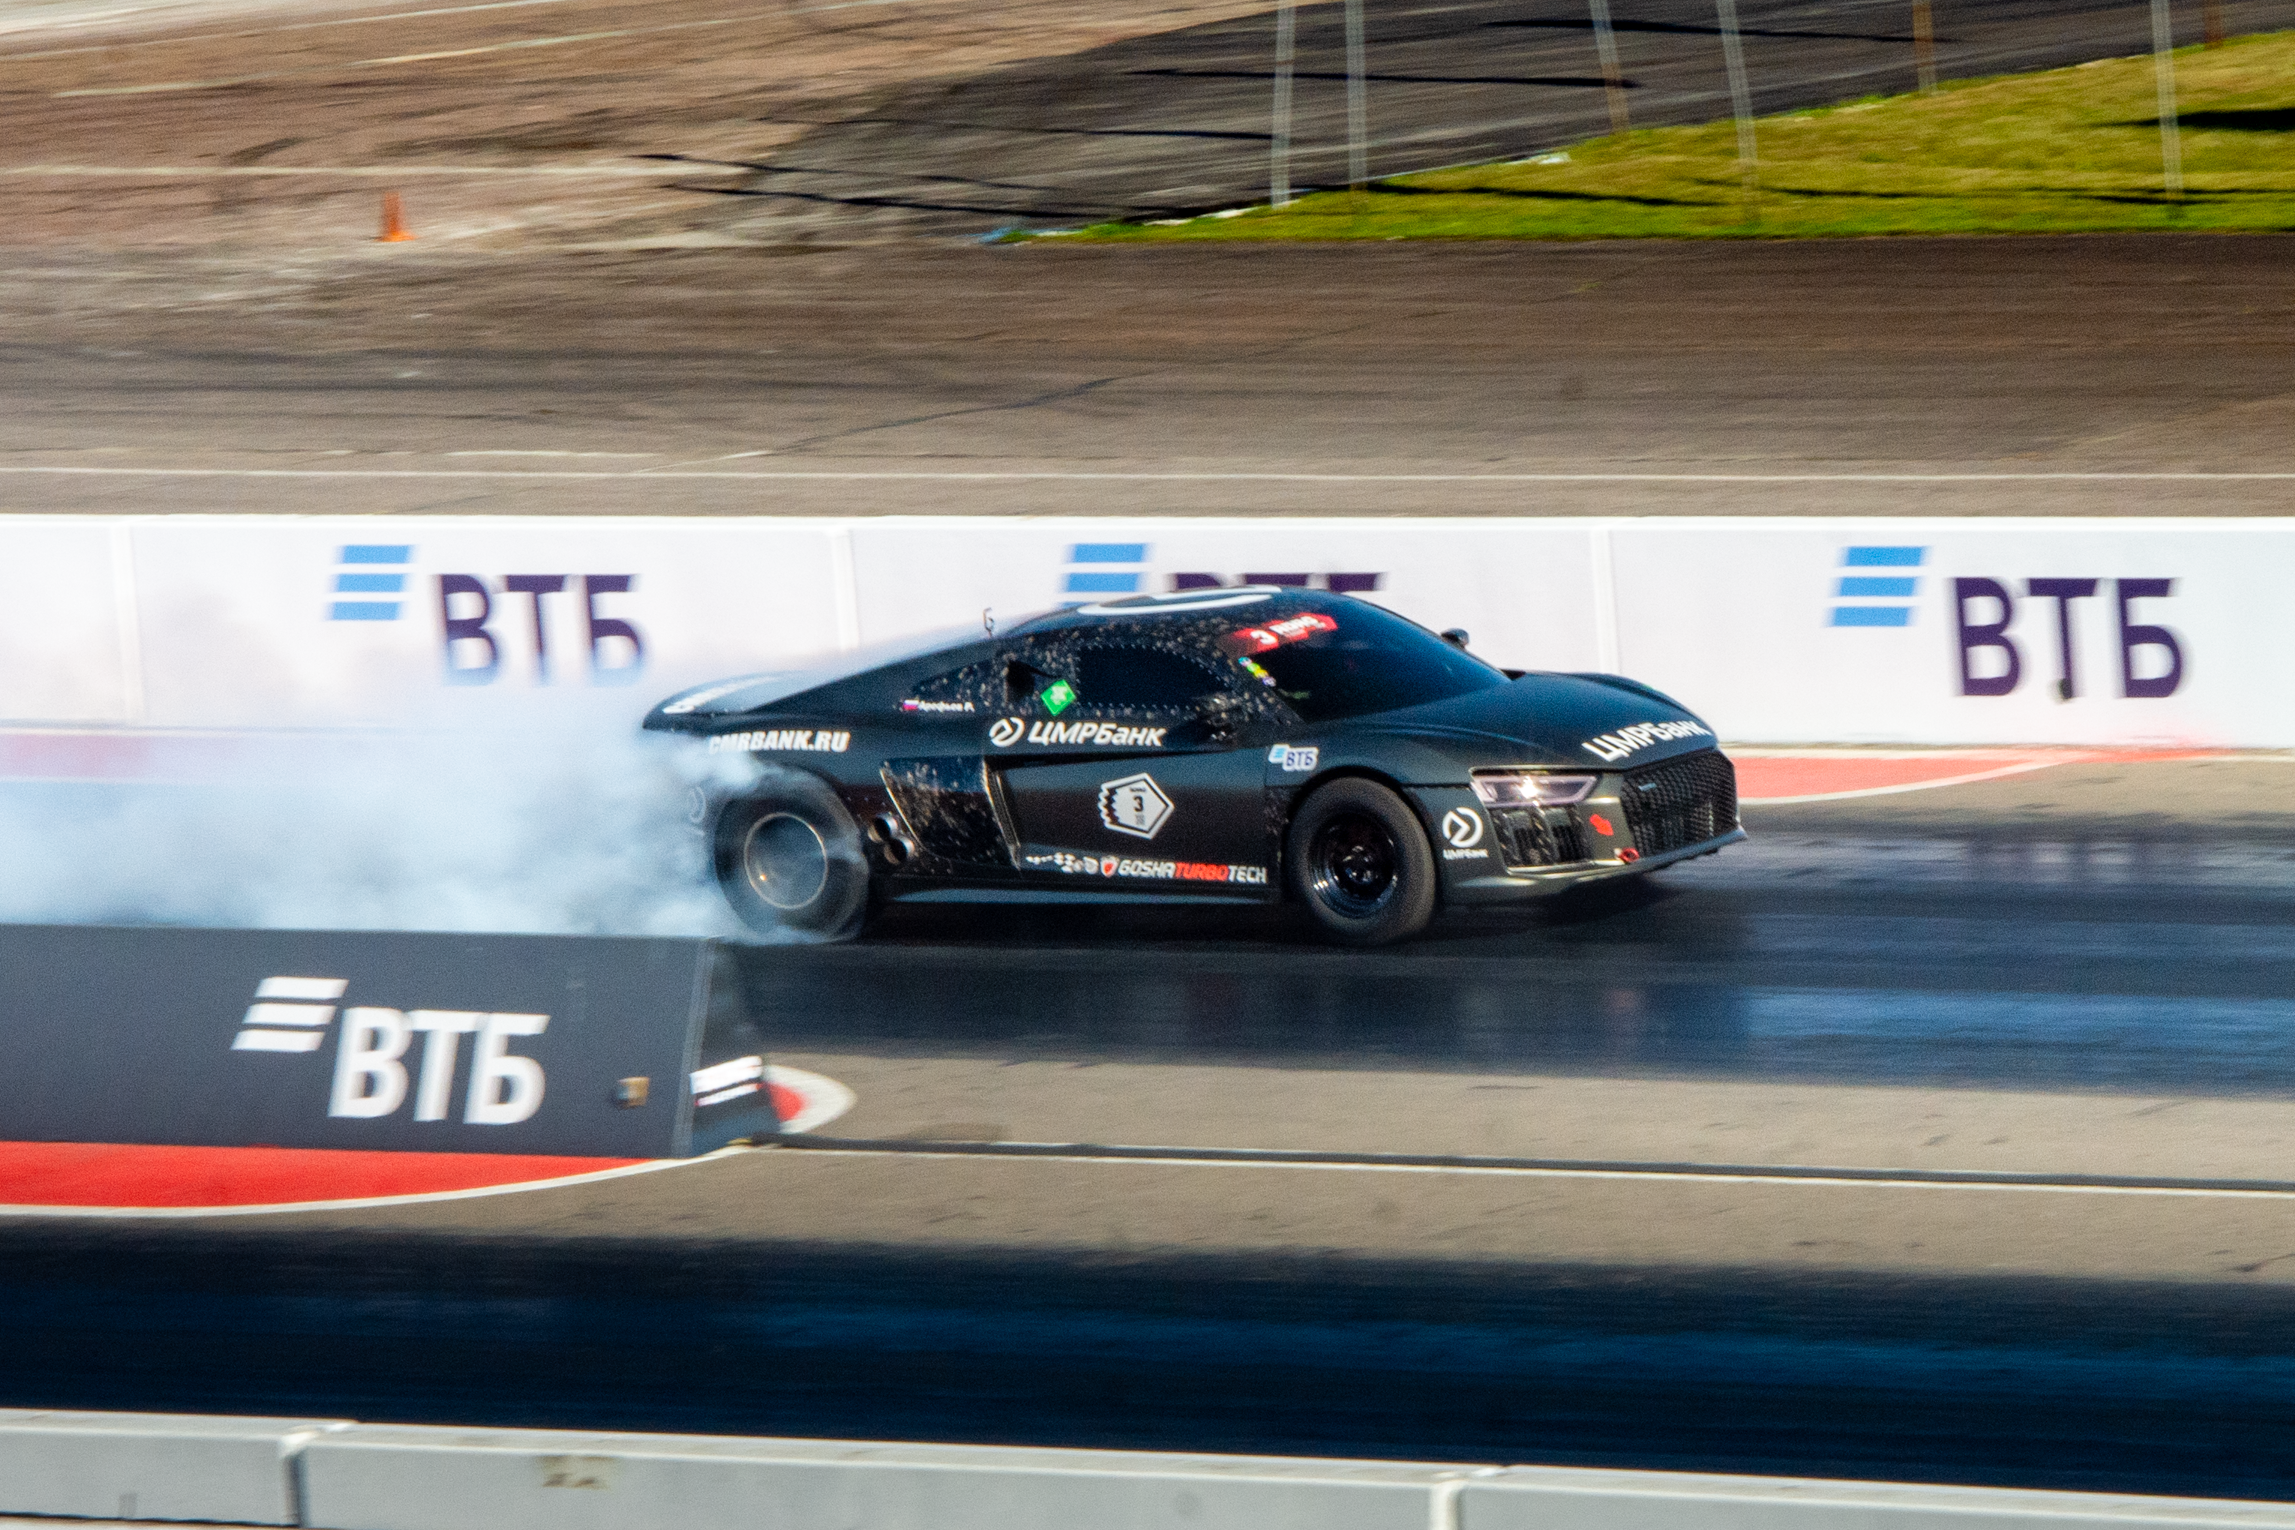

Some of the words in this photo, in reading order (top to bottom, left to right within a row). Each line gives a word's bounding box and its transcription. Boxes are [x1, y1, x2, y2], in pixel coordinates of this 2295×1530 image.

[433, 574, 651, 687] ВТБ
[1947, 577, 2189, 699] ВТБ
[708, 730, 851, 754] CMRBANK.RU
[1027, 720, 1167, 747] ЦМРБанк
[1581, 720, 1713, 762] ЦМРБанк
[1286, 751, 1314, 767] ВТБ
[1132, 795, 1145, 812] 3
[327, 1006, 551, 1125] ВТБ
